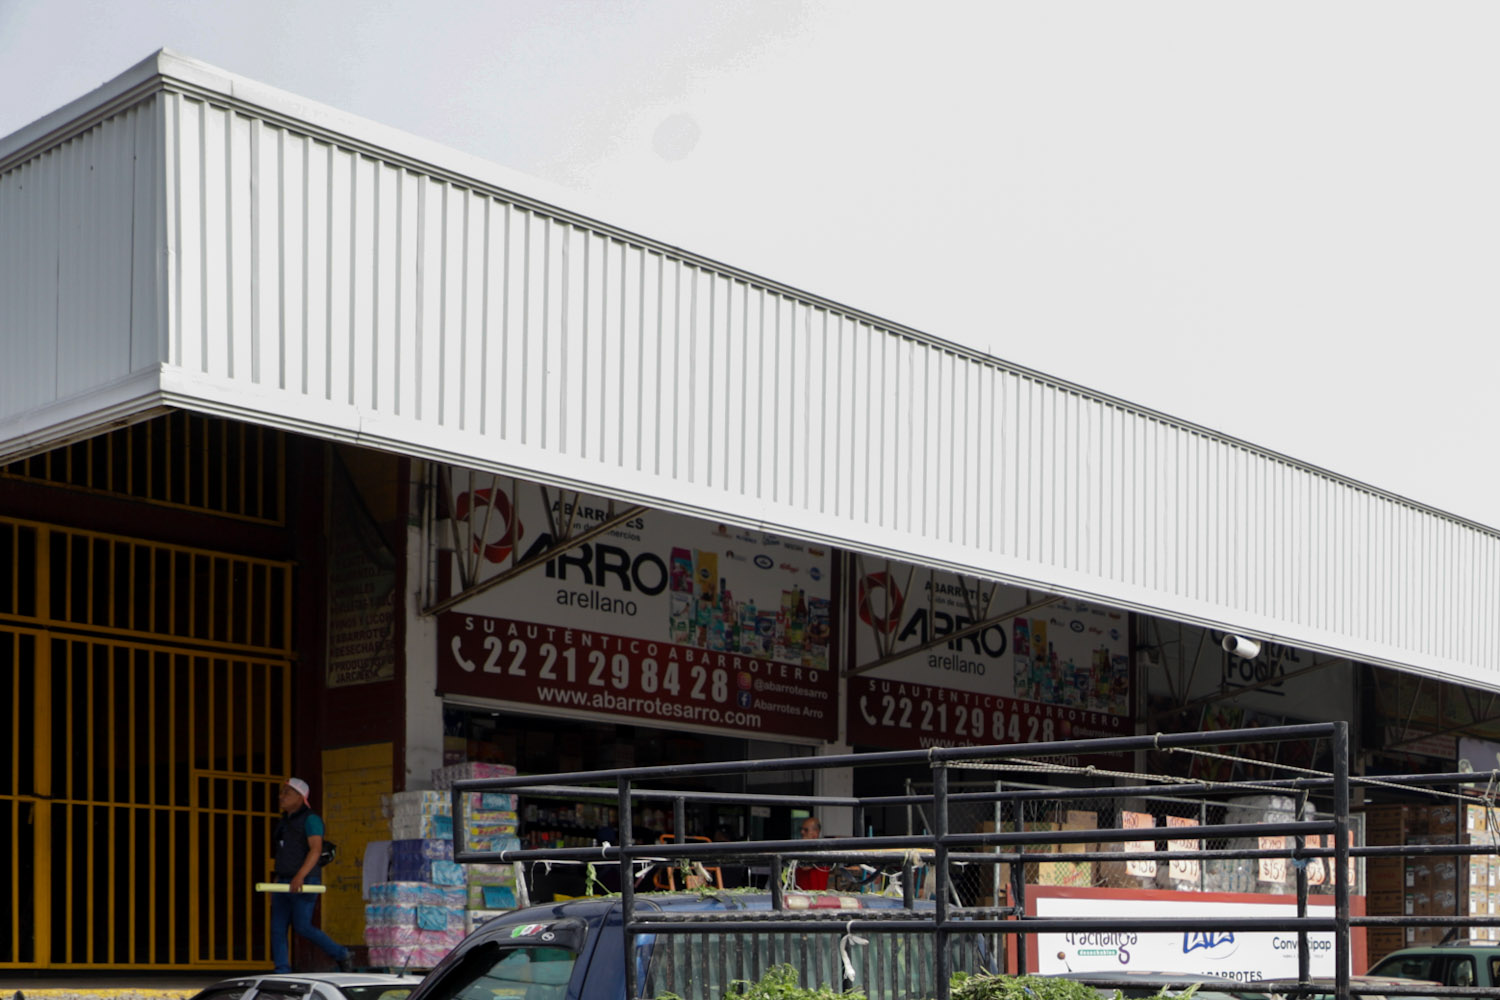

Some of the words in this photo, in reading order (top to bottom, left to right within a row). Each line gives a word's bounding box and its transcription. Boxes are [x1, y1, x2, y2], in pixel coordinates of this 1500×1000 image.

[517, 532, 669, 597] ARRO
[556, 588, 638, 616] arellano
[465, 616, 496, 633] SU
[507, 622, 659, 657] AUTÉNTICO
[669, 647, 820, 683] ABARROTERO
[482, 635, 527, 677] 22
[539, 643, 577, 683] 21
[587, 649, 630, 689] 29
[640, 657, 681, 697] 84
[690, 664, 729, 703] 28
[929, 654, 986, 676] arellano
[536, 684, 762, 728] www.abarrotesarro.com
[753, 698, 801, 715] Abarrotes
[881, 695, 913, 729] 22
[920, 700, 948, 733] 21
[954, 705, 986, 739] 29
[991, 711, 1021, 742] 84
[1027, 716, 1055, 743] 28
[897, 681, 1005, 709] AUTÉNTICO
[1011, 700, 1120, 728] ABARROTERO
